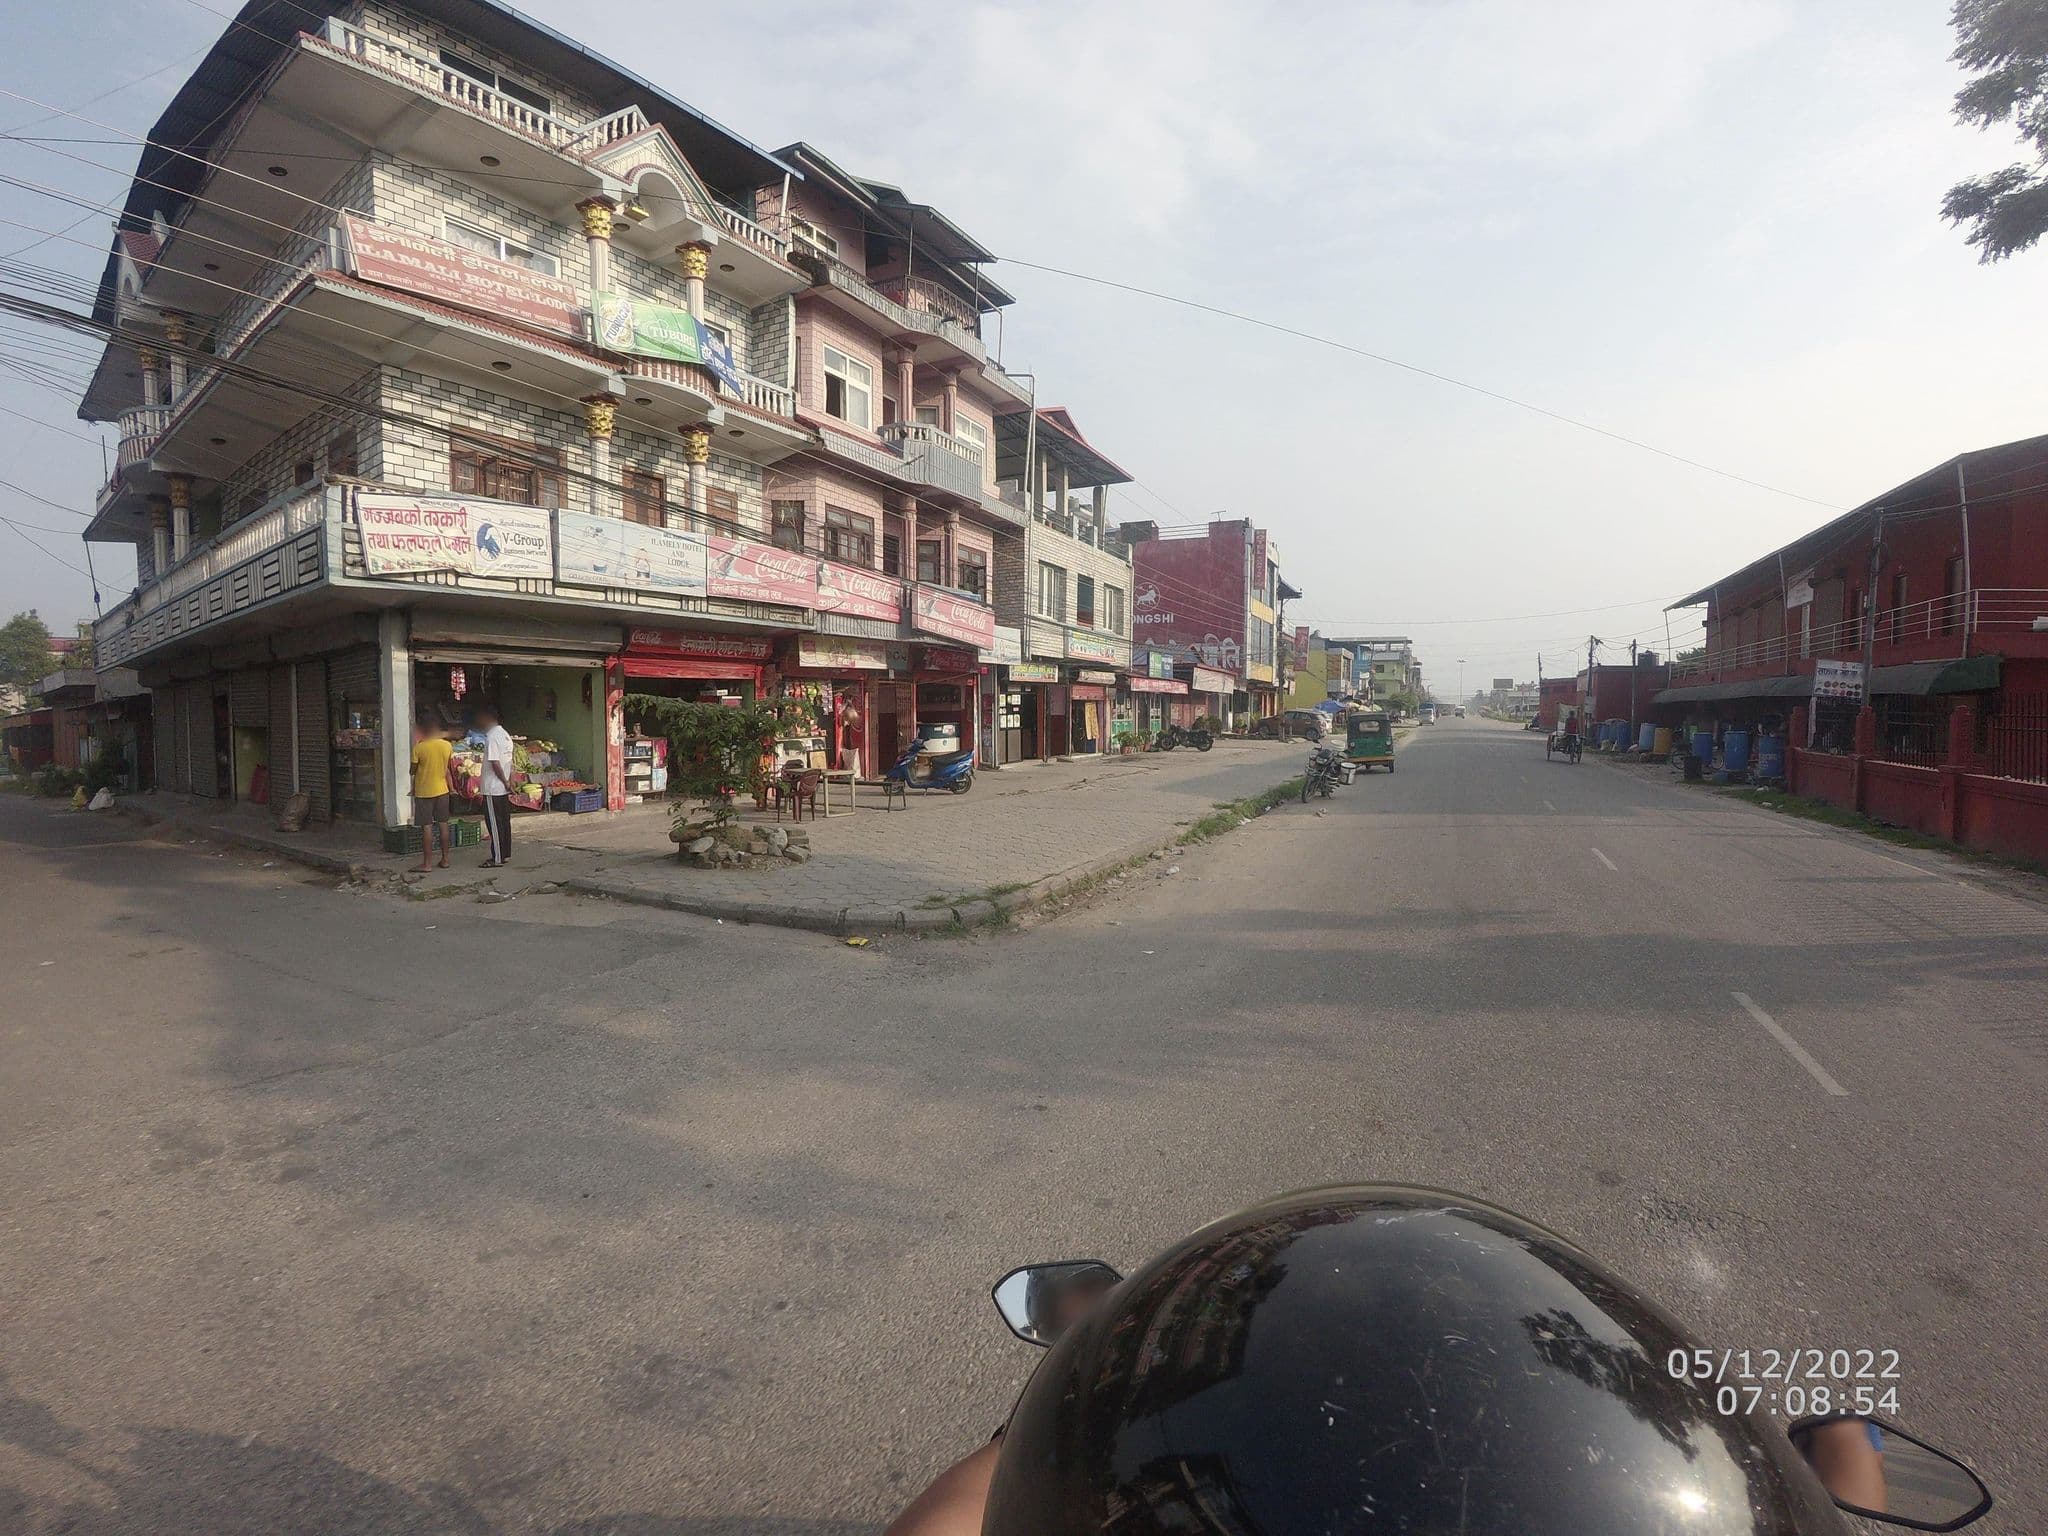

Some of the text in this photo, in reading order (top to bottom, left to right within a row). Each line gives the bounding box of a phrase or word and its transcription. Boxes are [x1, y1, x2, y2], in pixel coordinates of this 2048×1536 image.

[355, 242, 461, 280] ILAMALI
[463, 272, 530, 301] HOTEL
[423, 507, 468, 534] तरकारी
[366, 533, 390, 549] तथा
[502, 532, 544, 550] V-Group
[683, 542, 702, 552] HOTEL
[672, 550, 685, 558] AND
